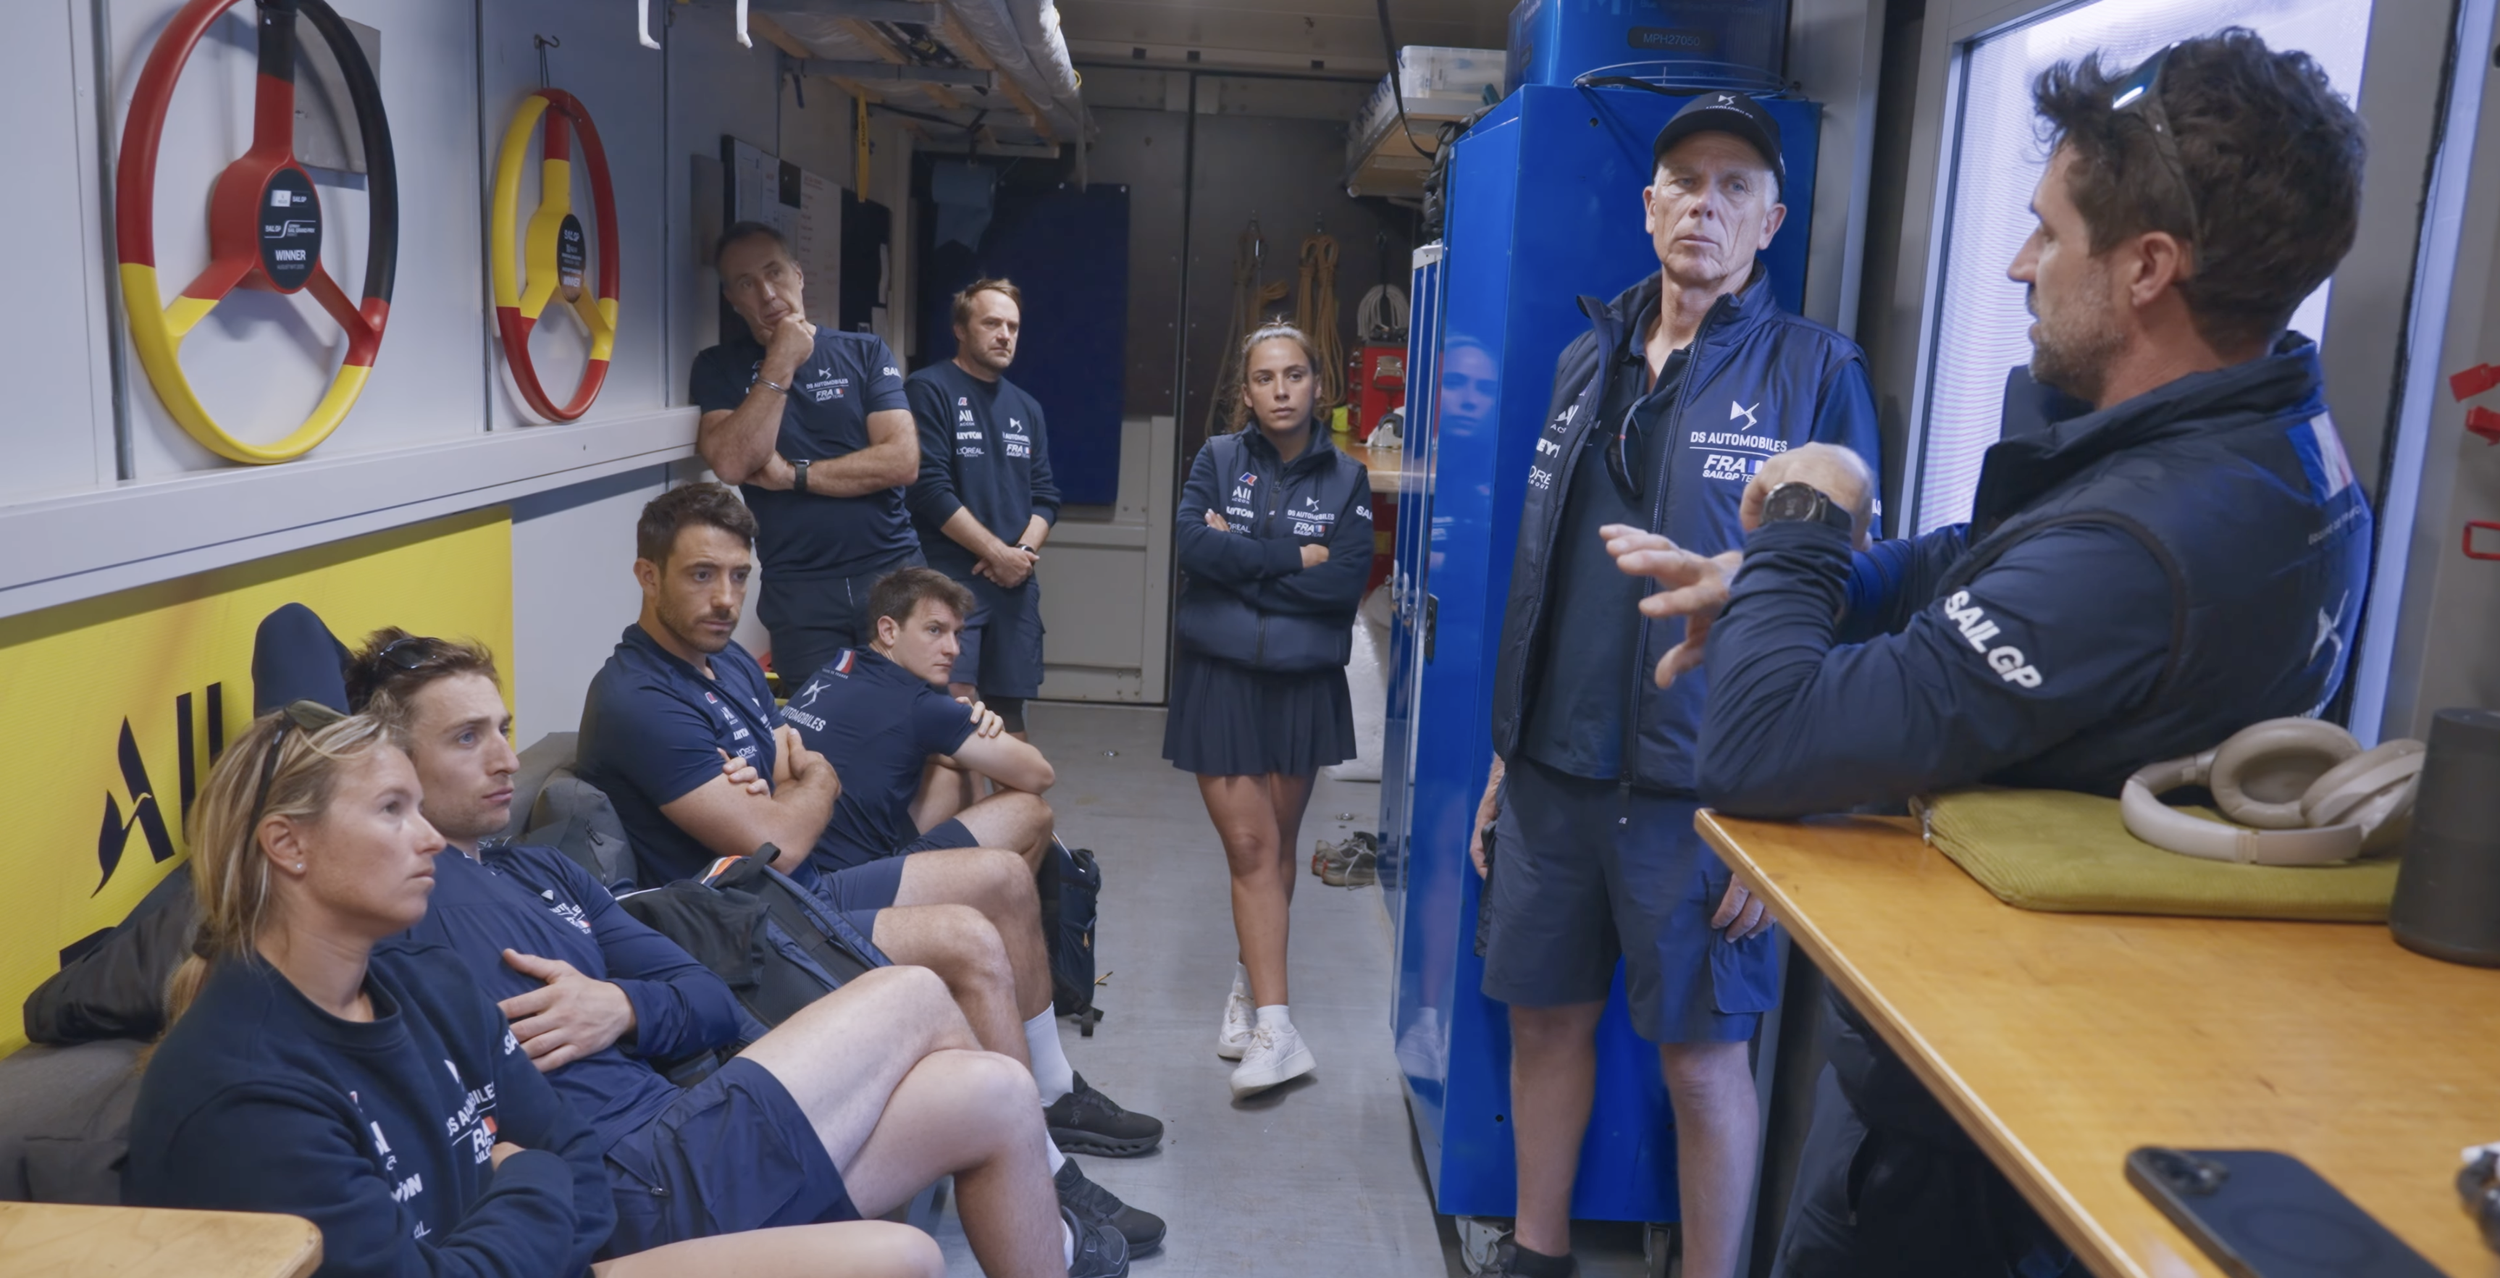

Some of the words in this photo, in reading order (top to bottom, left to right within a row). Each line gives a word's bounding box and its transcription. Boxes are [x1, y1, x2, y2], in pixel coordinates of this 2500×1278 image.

[1643, 33, 1700, 47] MPH27050
[275, 249, 306, 261] WINNER
[814, 378, 849, 389] AUTOMOBILES
[816, 388, 834, 398] FRA
[1006, 443, 1023, 453] FRA
[1690, 431, 1706, 443] DS
[1707, 432, 1788, 453] AUTOMOBILES
[1703, 454, 1746, 473] FRA
[1702, 469, 1740, 481] SAILGP
[1294, 521, 1315, 533] FRA
